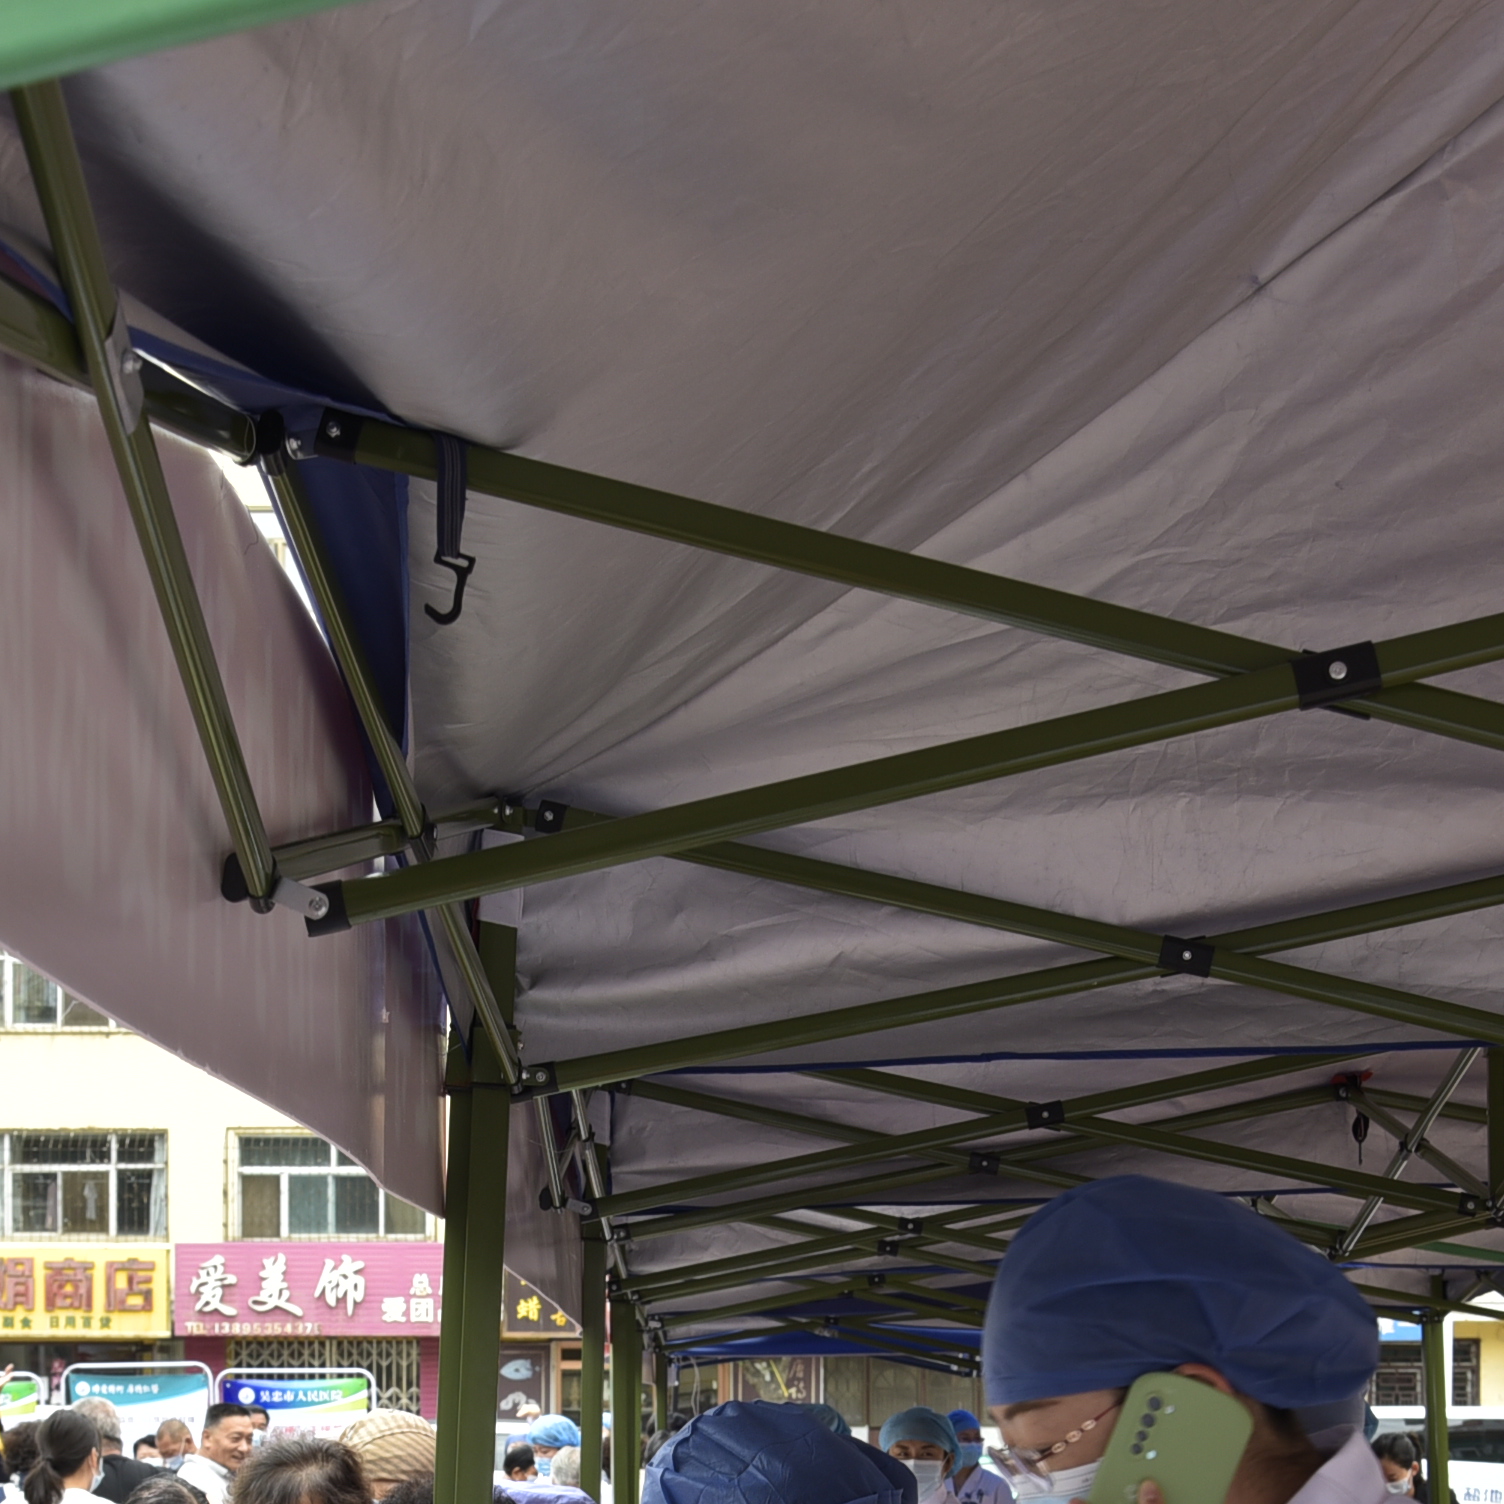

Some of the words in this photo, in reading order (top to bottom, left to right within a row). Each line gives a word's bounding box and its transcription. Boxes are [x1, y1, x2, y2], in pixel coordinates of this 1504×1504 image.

[189, 1253, 366, 1318] 爱美饰
[409, 1273, 444, 1297] 总
[381, 1297, 443, 1323] 爱团
[259, 1388, 344, 1403] 吴忠市人民医院
